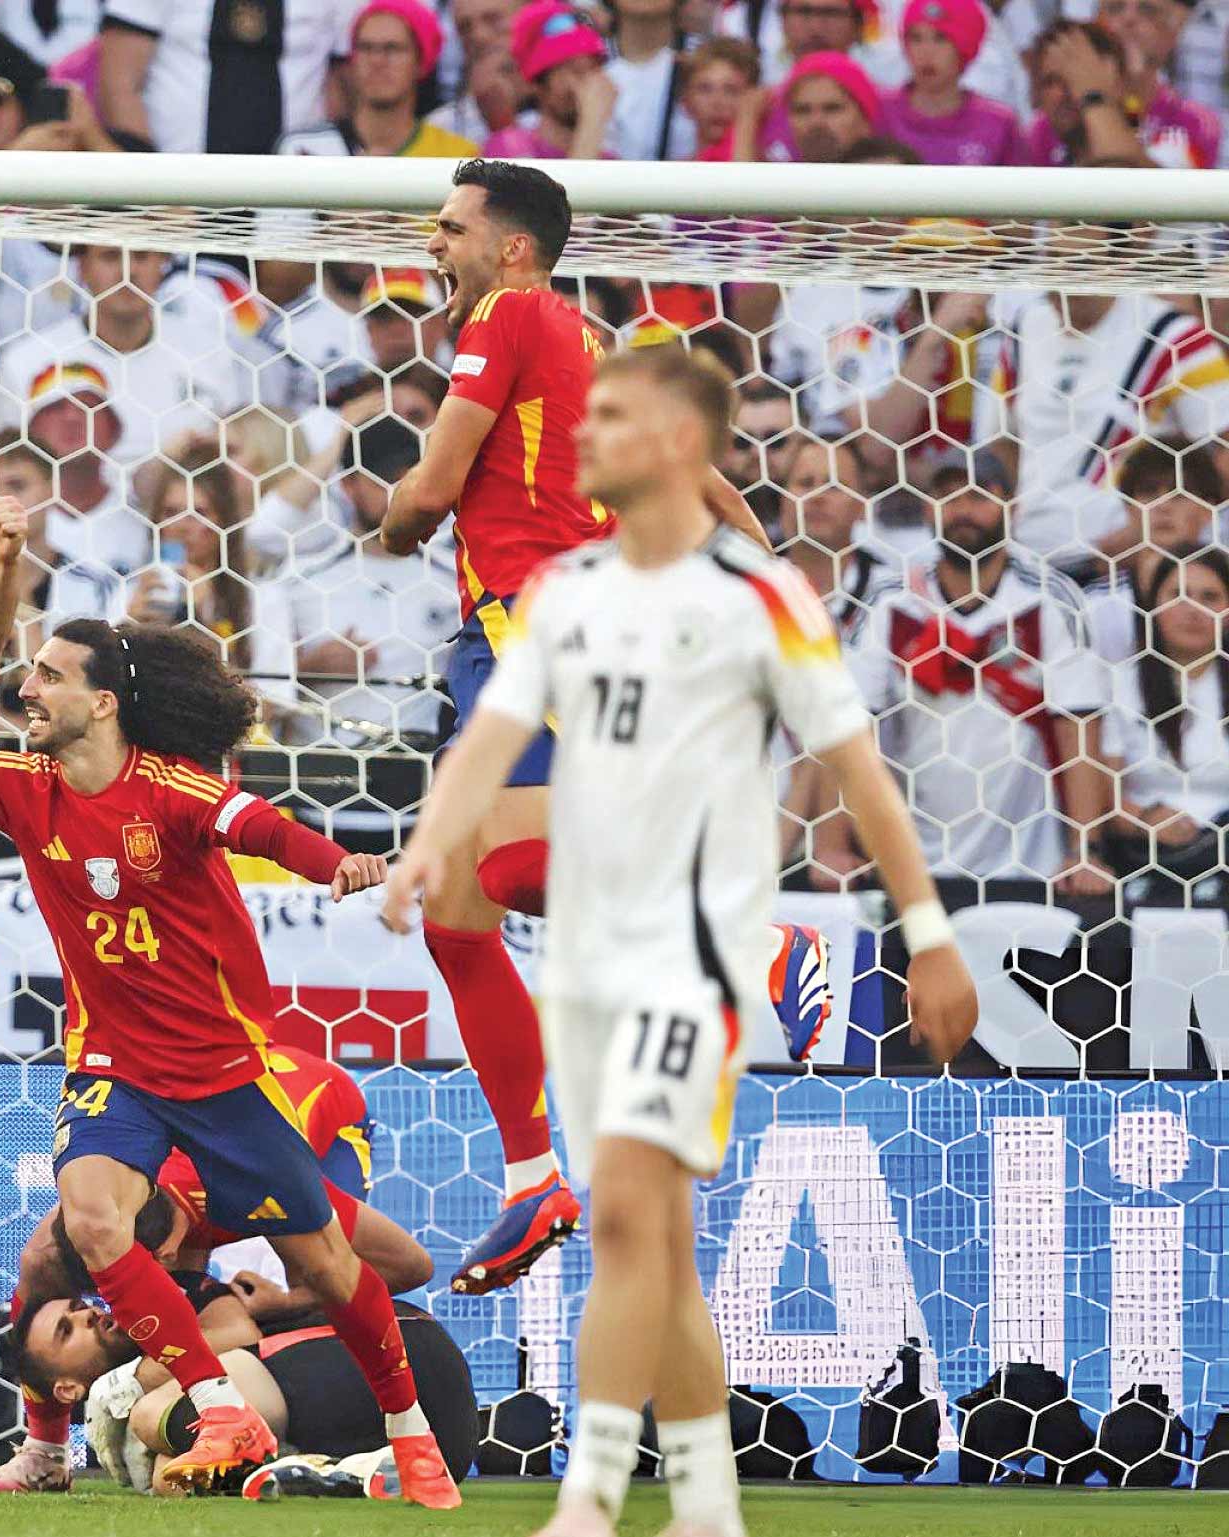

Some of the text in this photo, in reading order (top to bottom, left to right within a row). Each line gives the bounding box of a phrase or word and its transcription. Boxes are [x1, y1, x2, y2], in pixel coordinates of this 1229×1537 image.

[590, 675, 644, 744] 18
[86, 906, 160, 964] 24
[630, 1010, 699, 1082] 18
